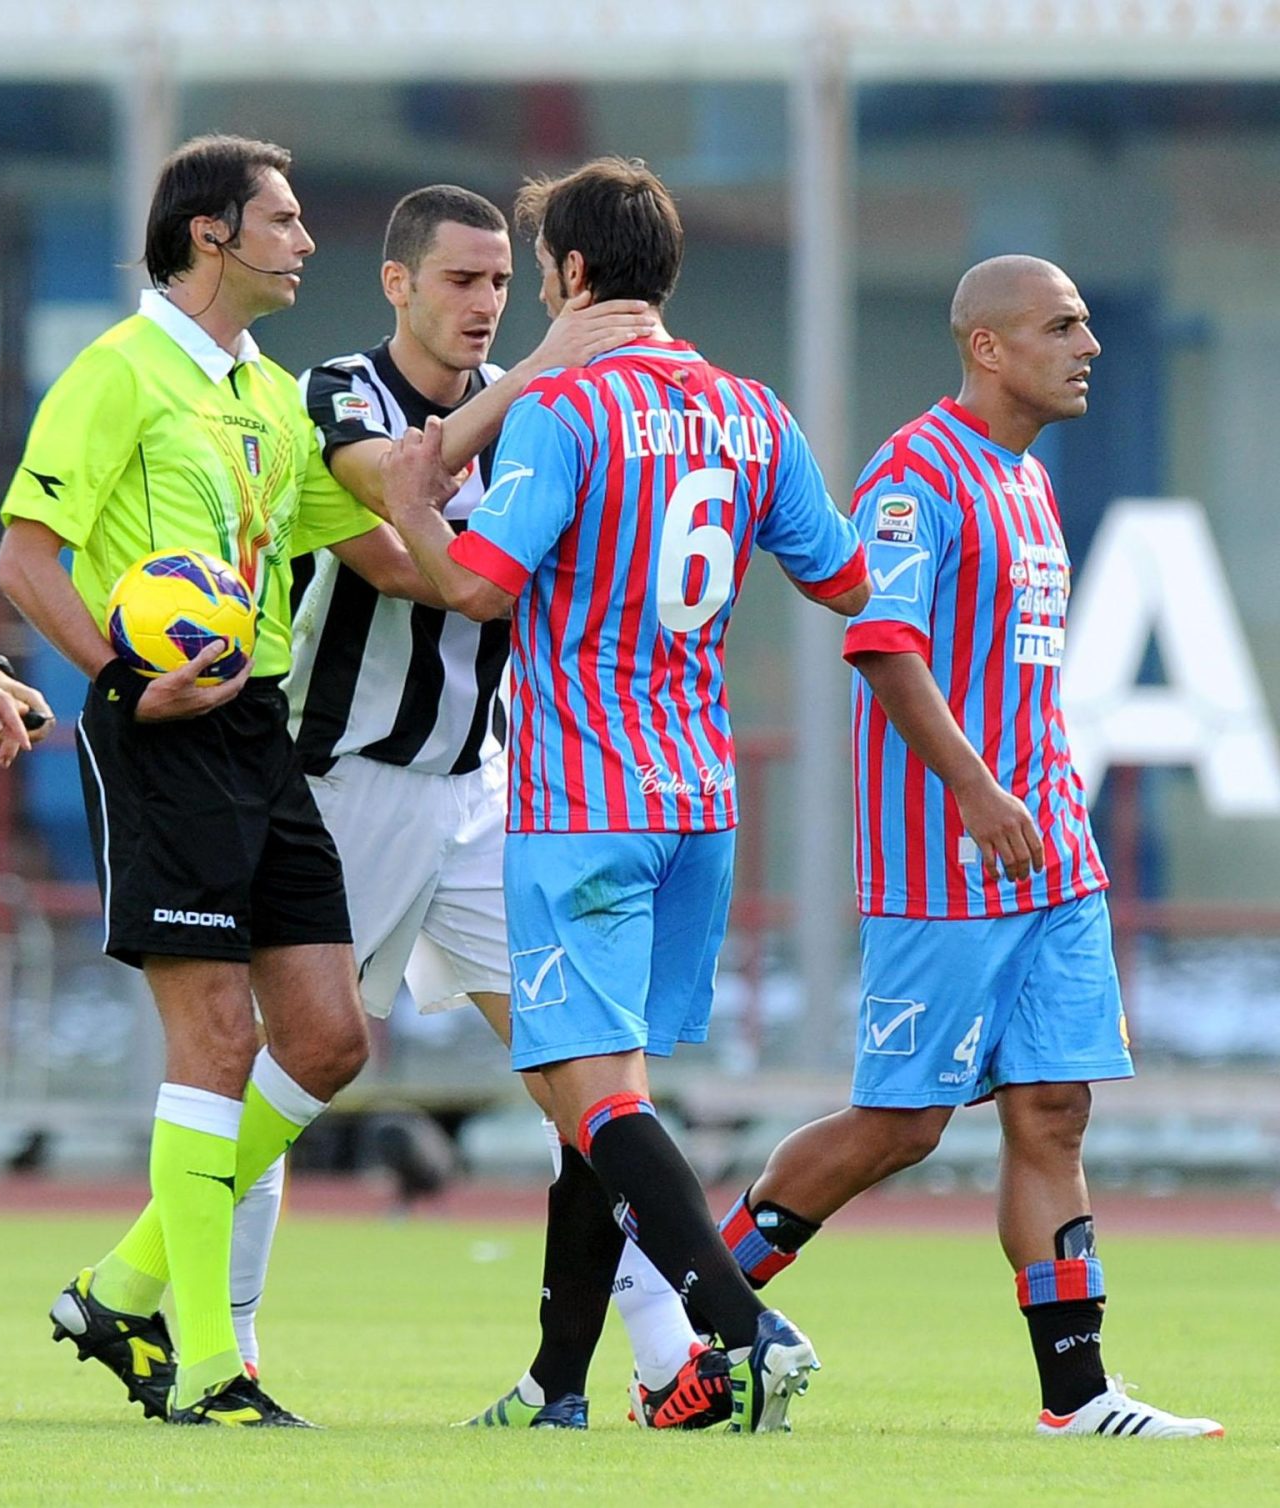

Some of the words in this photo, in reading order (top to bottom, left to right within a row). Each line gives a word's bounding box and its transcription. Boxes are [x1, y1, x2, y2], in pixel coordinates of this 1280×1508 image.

[222, 414, 268, 434] DIADORA
[622, 408, 774, 465] LEGROTTAGLIE
[656, 467, 736, 633] 6
[153, 908, 237, 929] DIADORA
[953, 1014, 984, 1068] 4
